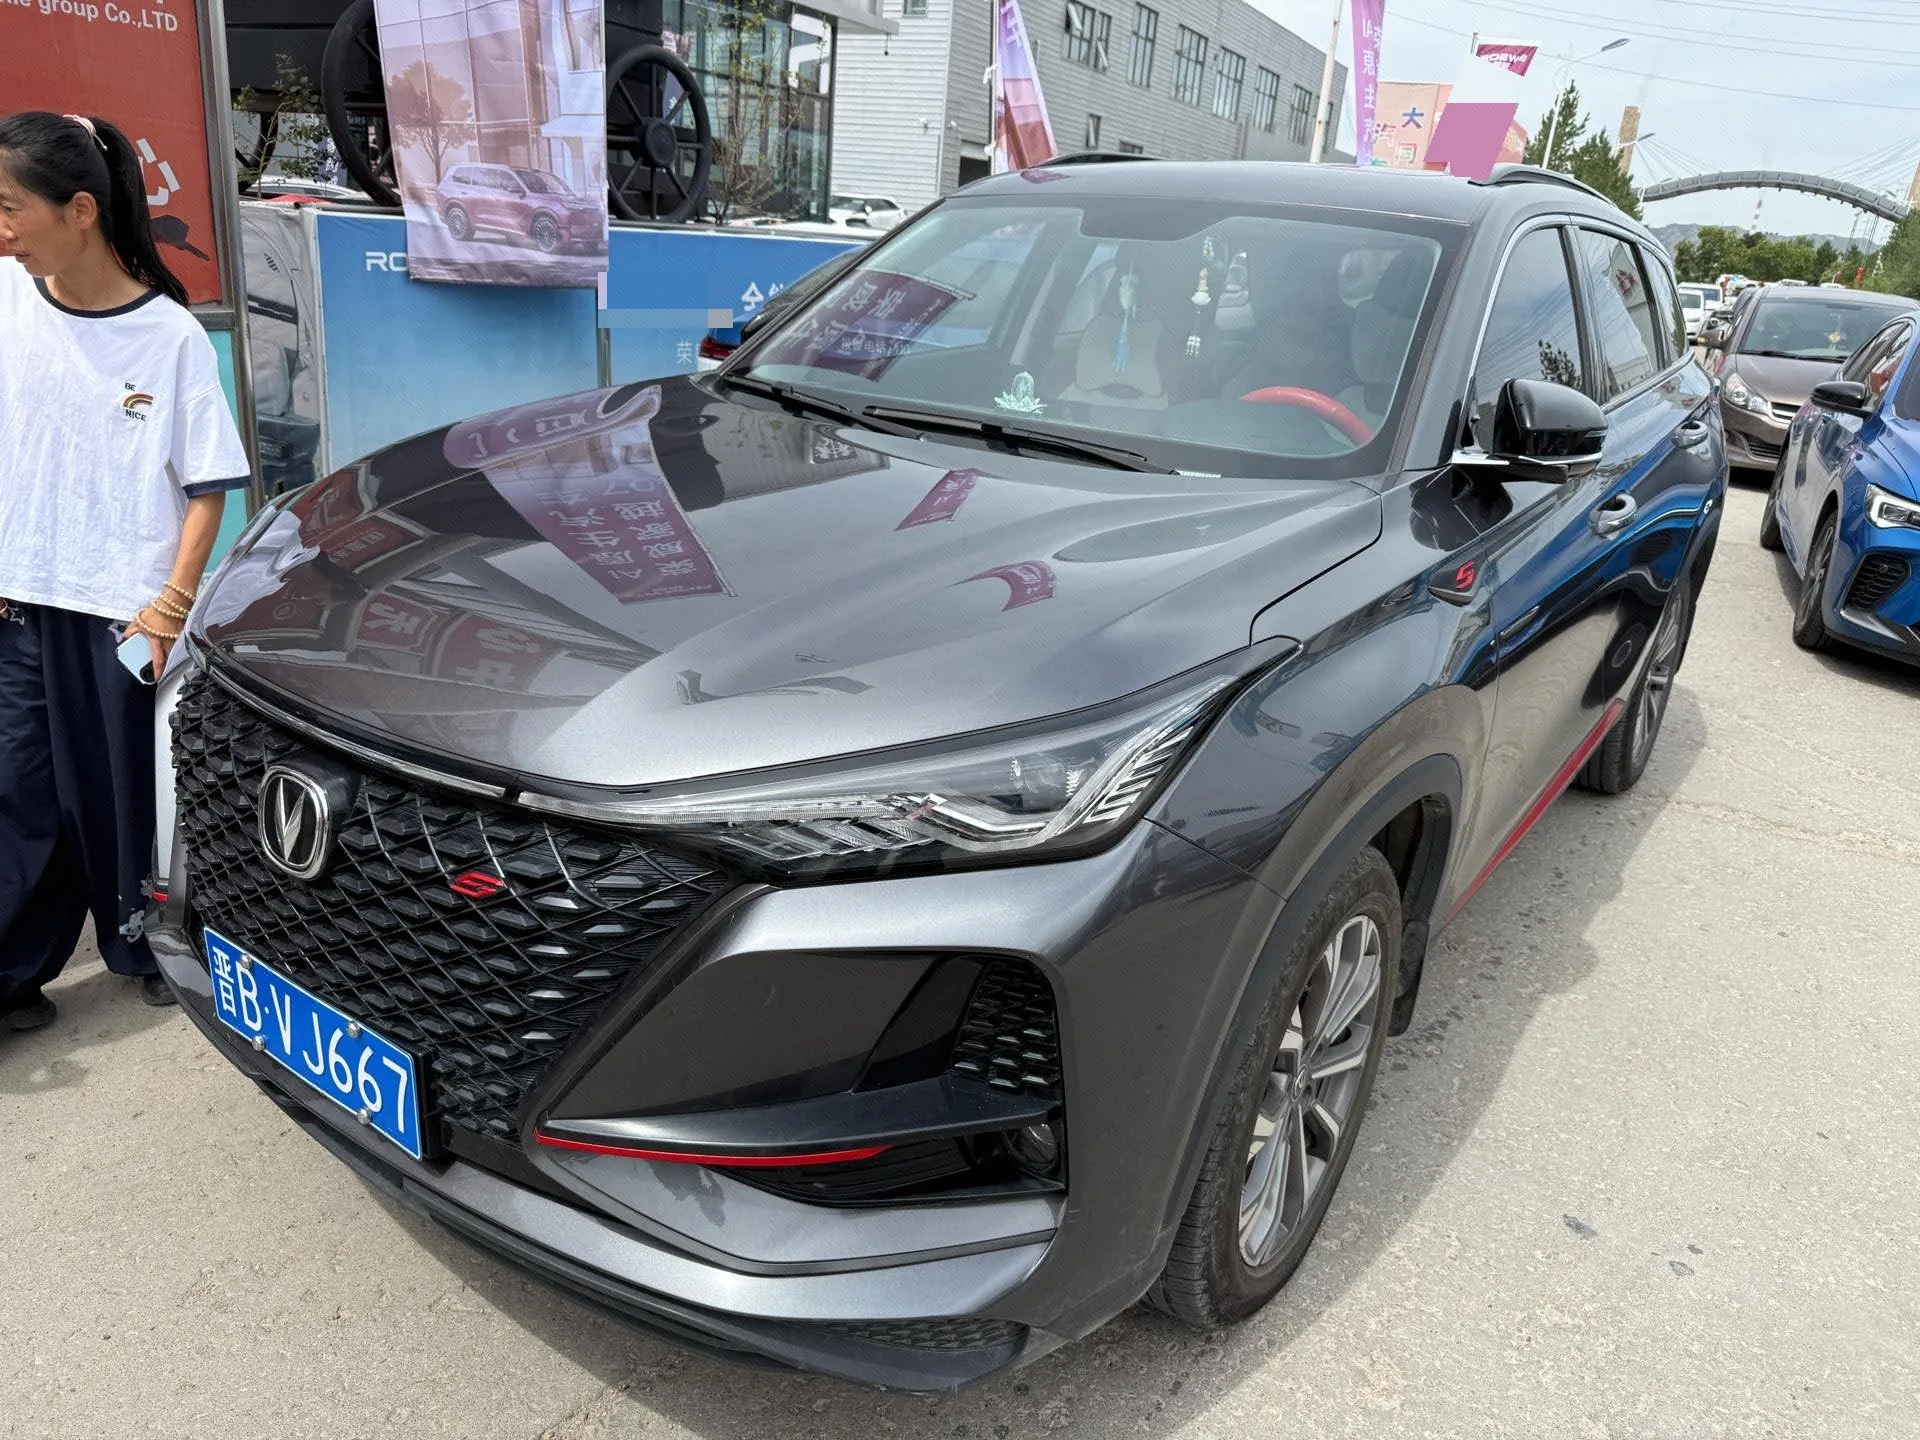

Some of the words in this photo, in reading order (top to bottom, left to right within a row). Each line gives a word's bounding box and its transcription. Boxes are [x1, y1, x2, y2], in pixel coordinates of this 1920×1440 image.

[104, 3, 178, 32] Co.,LTD
[125, 382, 136, 391] BE
[125, 409, 147, 421] NICE
